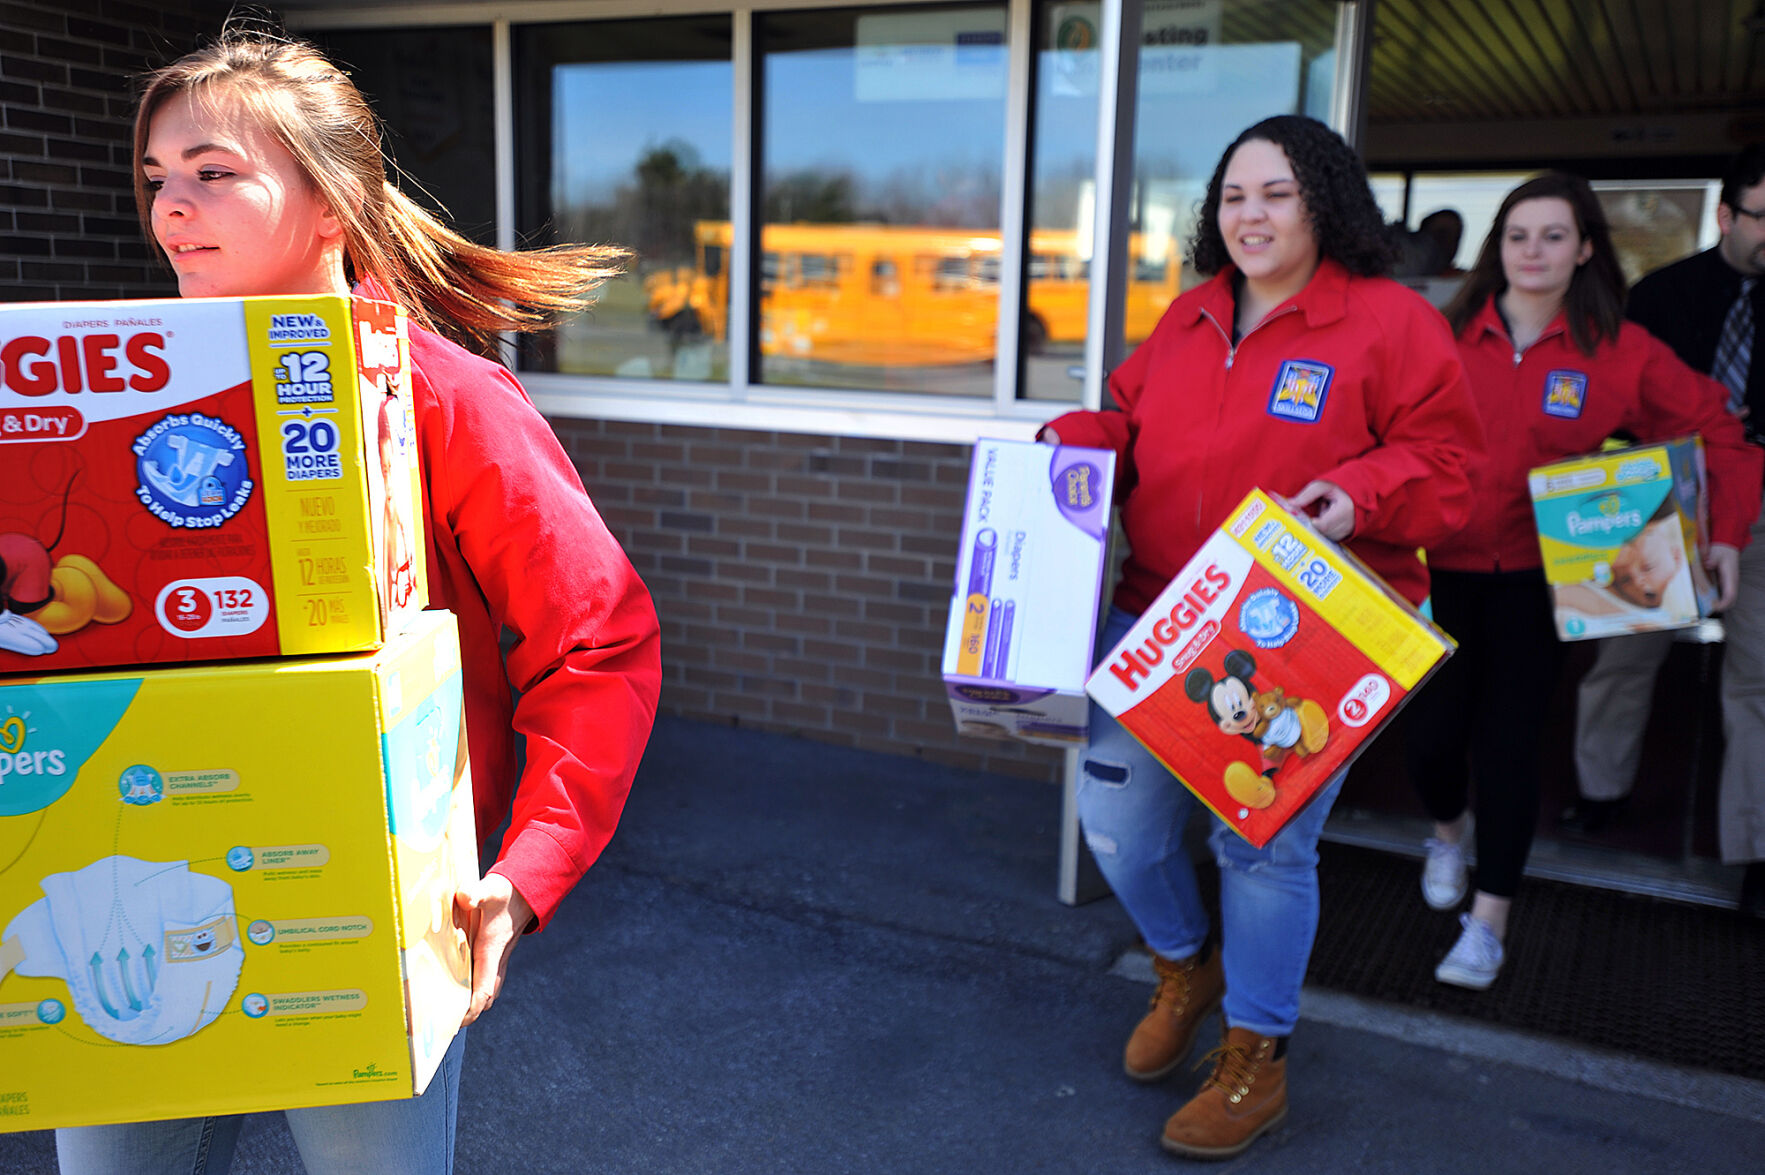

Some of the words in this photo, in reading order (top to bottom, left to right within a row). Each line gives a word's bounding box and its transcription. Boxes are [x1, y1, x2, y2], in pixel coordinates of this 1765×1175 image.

[63, 320, 109, 329] DIAPERS
[114, 317, 163, 328] PAÑALES
[271, 314, 316, 328] NEW
[268, 327, 330, 340] IMPROVED
[0, 331, 171, 397] GIES
[279, 351, 331, 383] 12
[276, 382, 333, 396] HOUR
[3, 414, 24, 432] &
[132, 414, 189, 456] Absorbs
[190, 414, 245, 451] Quickly
[283, 421, 336, 454] 20
[286, 454, 339, 469] MORE
[983, 448, 998, 487] VALUE
[287, 468, 341, 480] DIAPERS
[136, 484, 154, 504] To
[148, 500, 185, 528] Help
[183, 513, 224, 528] Stop
[220, 480, 253, 519] Leaks
[979, 489, 992, 522] PACK
[1566, 509, 1643, 537] Pampers
[1009, 531, 1027, 580] Diapers
[1271, 531, 1298, 560] 12
[298, 558, 315, 586] 12
[1299, 559, 1327, 588] 20
[176, 589, 197, 613] 3
[213, 588, 254, 609] 132
[968, 602, 985, 614] 2
[1109, 564, 1232, 692] HUGGIES
[968, 633, 980, 655] 160
[1345, 699, 1362, 716] 2
[168, 775, 195, 783] EXTRA
[279, 927, 317, 935] UMBILICAL
[318, 925, 340, 933] CORD
[272, 996, 321, 1005] SWADDLERS
[323, 993, 361, 1001] WETNESS
